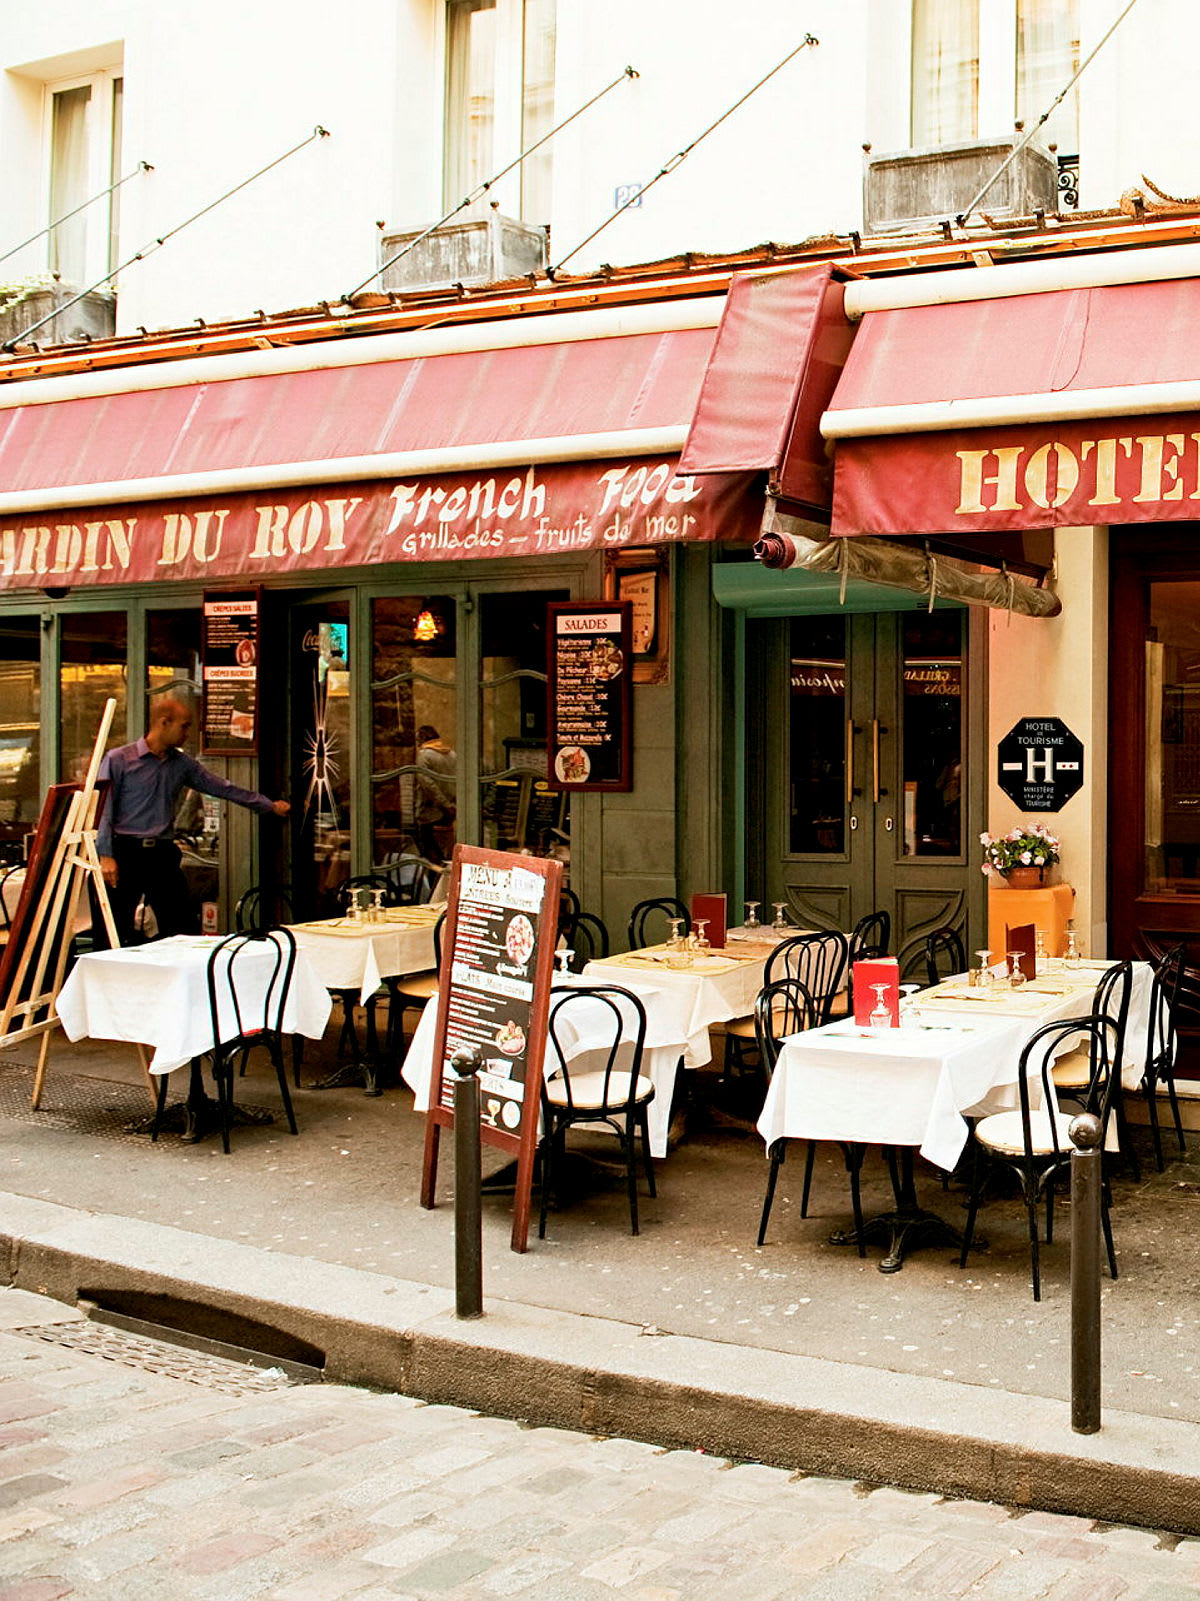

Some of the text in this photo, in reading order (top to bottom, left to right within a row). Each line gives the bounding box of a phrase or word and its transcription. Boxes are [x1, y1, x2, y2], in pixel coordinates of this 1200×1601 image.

[386, 464, 547, 535] French
[157, 510, 230, 565] DU
[249, 497, 363, 559] ROY
[604, 514, 632, 541] de
[645, 513, 697, 538] mer
[564, 618, 608, 631] SALADES
[1017, 736, 1064, 745] TOURISME
[1025, 722, 1056, 731] HOTEL
[1025, 747, 1055, 784] H
